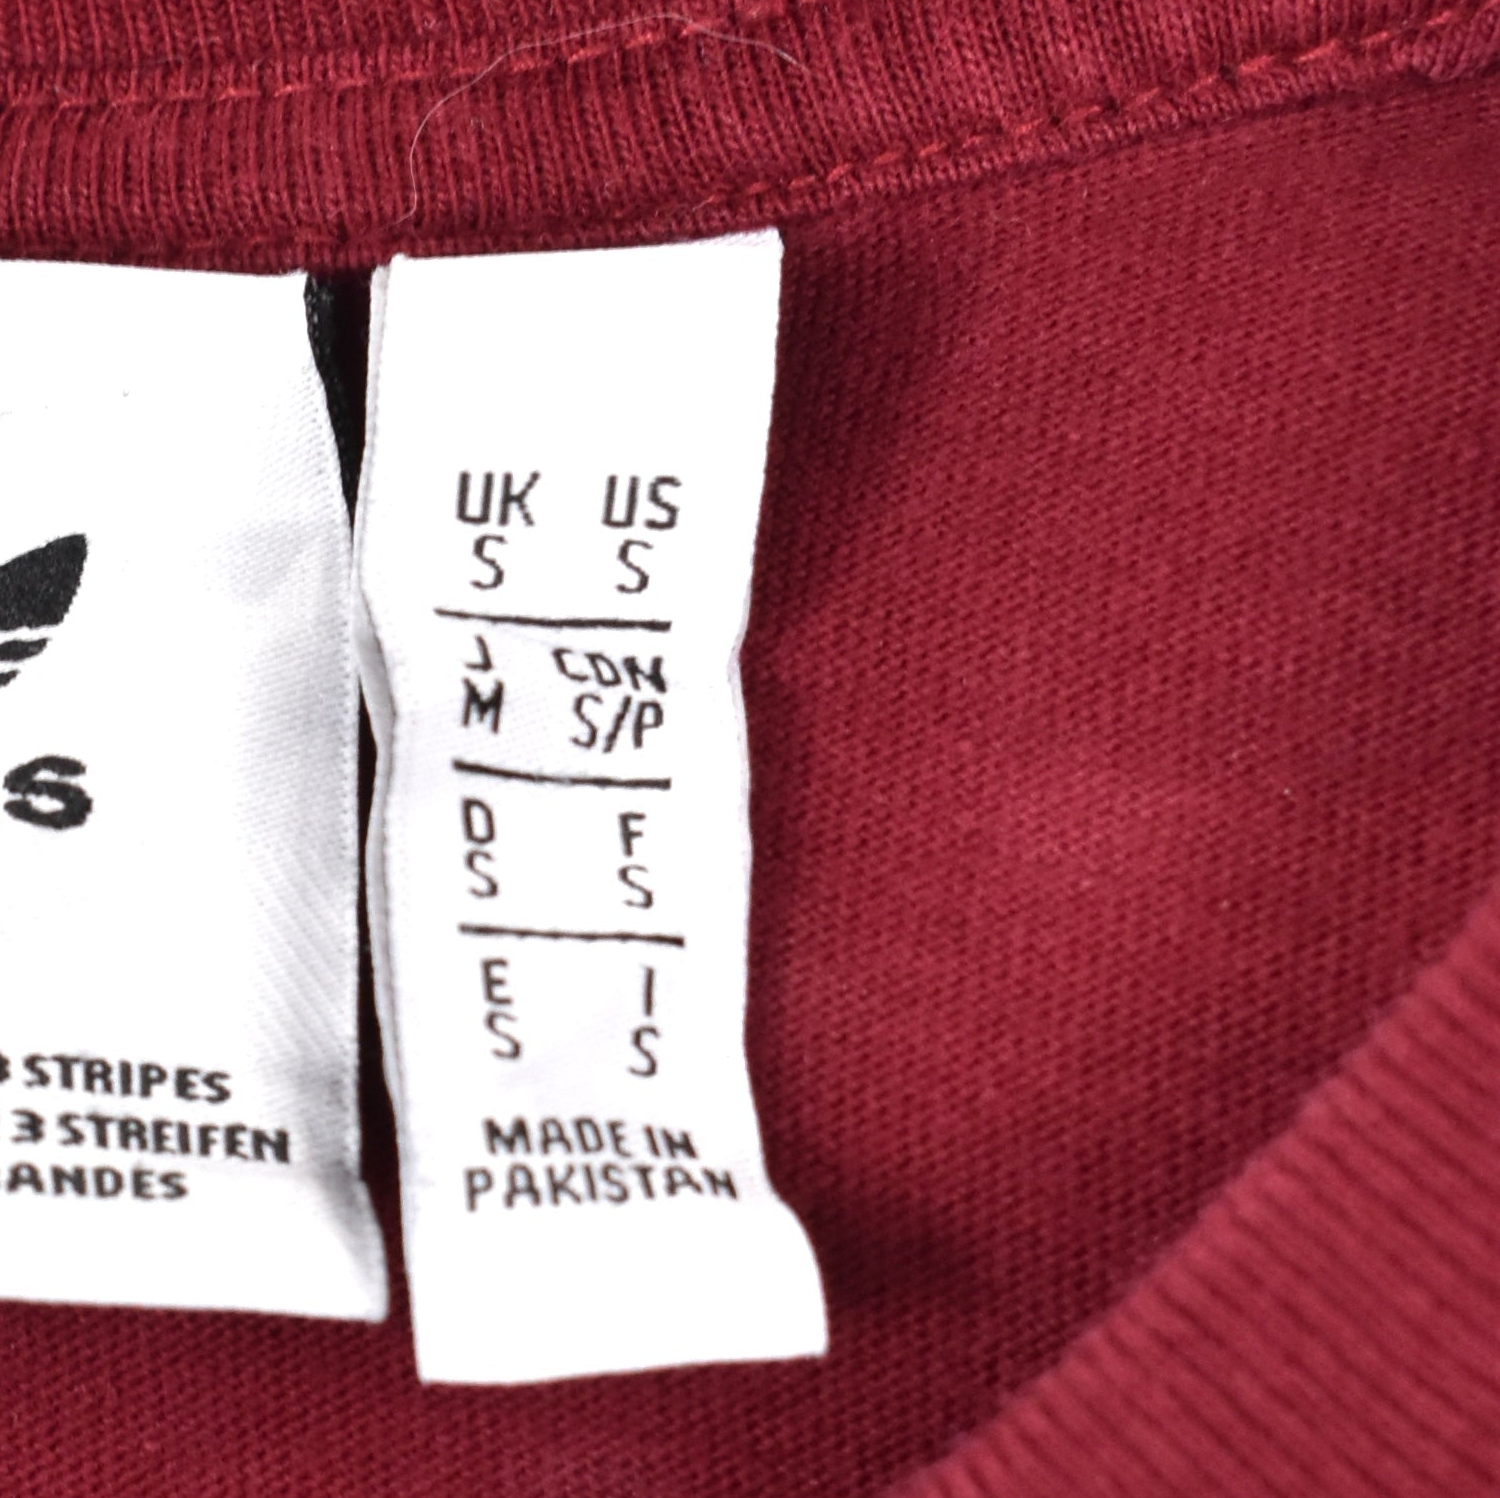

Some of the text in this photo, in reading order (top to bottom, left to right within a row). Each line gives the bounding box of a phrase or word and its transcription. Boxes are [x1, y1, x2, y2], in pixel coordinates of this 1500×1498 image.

[456, 470, 682, 531] UK US
[470, 533, 653, 594] S S
[551, 646, 668, 694] CDN
[461, 677, 665, 754] M S/P
[461, 797, 646, 857] D F
[463, 848, 654, 909] S S
[481, 958, 654, 1017] E I
[483, 1011, 660, 1078] S S
[23, 1053, 231, 1103] STRIPES
[12, 1109, 45, 1143] 3
[56, 1111, 291, 1165] STREIFEN
[483, 1117, 698, 1160] MADE IN
[464, 1163, 738, 1212] PAKISTAN
